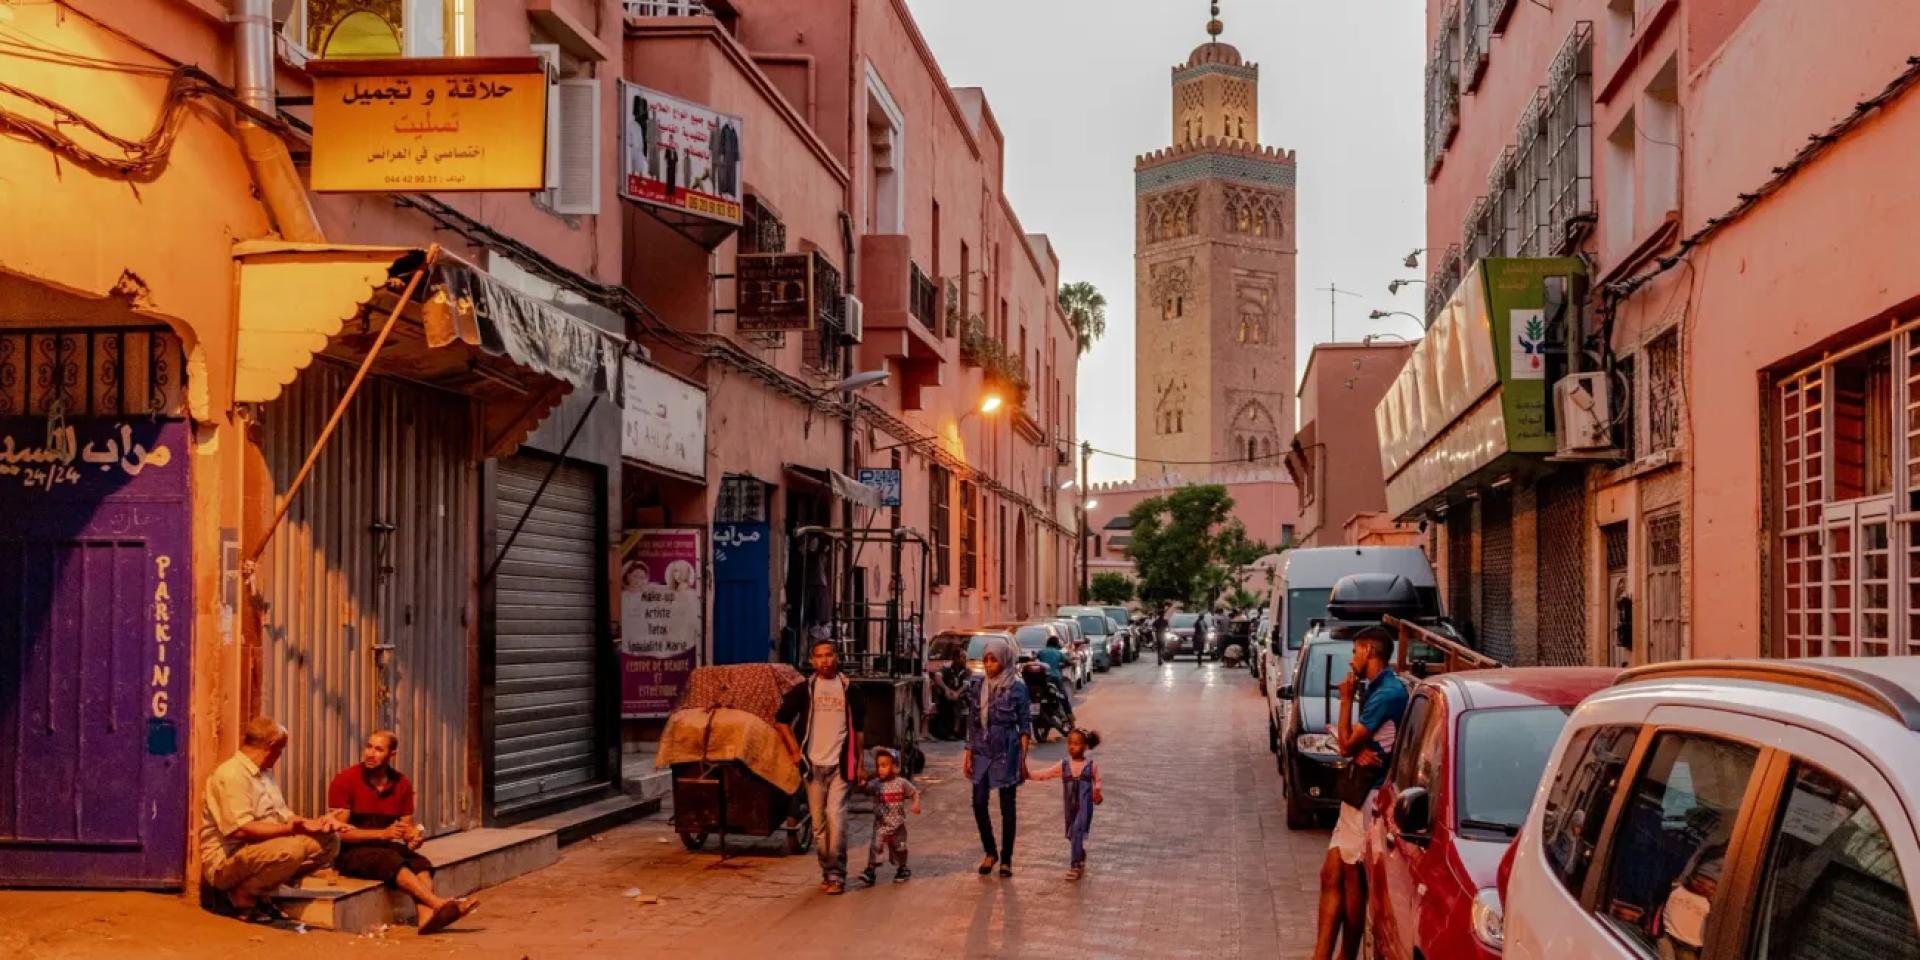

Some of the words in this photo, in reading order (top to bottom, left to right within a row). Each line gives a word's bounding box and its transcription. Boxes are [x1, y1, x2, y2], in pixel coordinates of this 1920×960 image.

[343, 79, 412, 105] تجميل
[421, 86, 435, 105] و
[447, 78, 513, 100] حلاقة
[415, 145, 428, 165] في
[23, 464, 81, 491] 24/24
[645, 607, 671, 619] Artiste
[151, 555, 172, 719] PARKING
